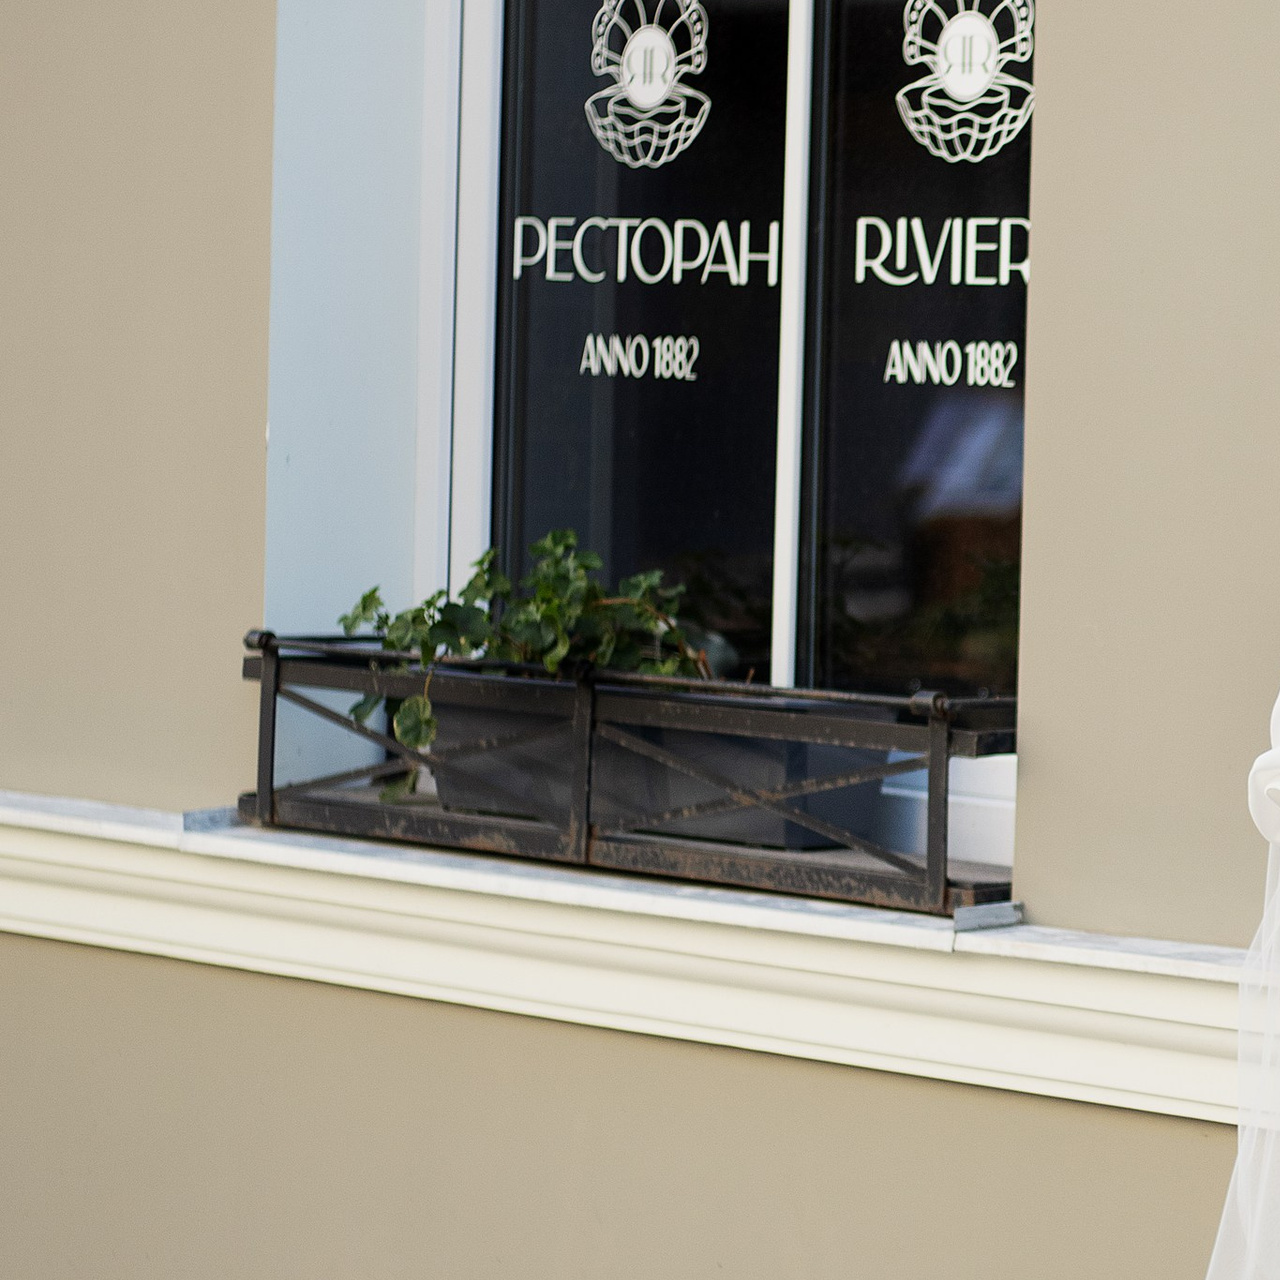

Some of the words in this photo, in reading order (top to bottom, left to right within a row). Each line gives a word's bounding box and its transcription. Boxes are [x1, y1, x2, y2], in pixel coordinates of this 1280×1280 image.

[512, 216, 780, 287] РЕСТОРАН
[580, 333, 650, 379] ANNO
[652, 335, 700, 381] 1882
[883, 339, 963, 386] ANNO
[964, 340, 1018, 388] 1882
